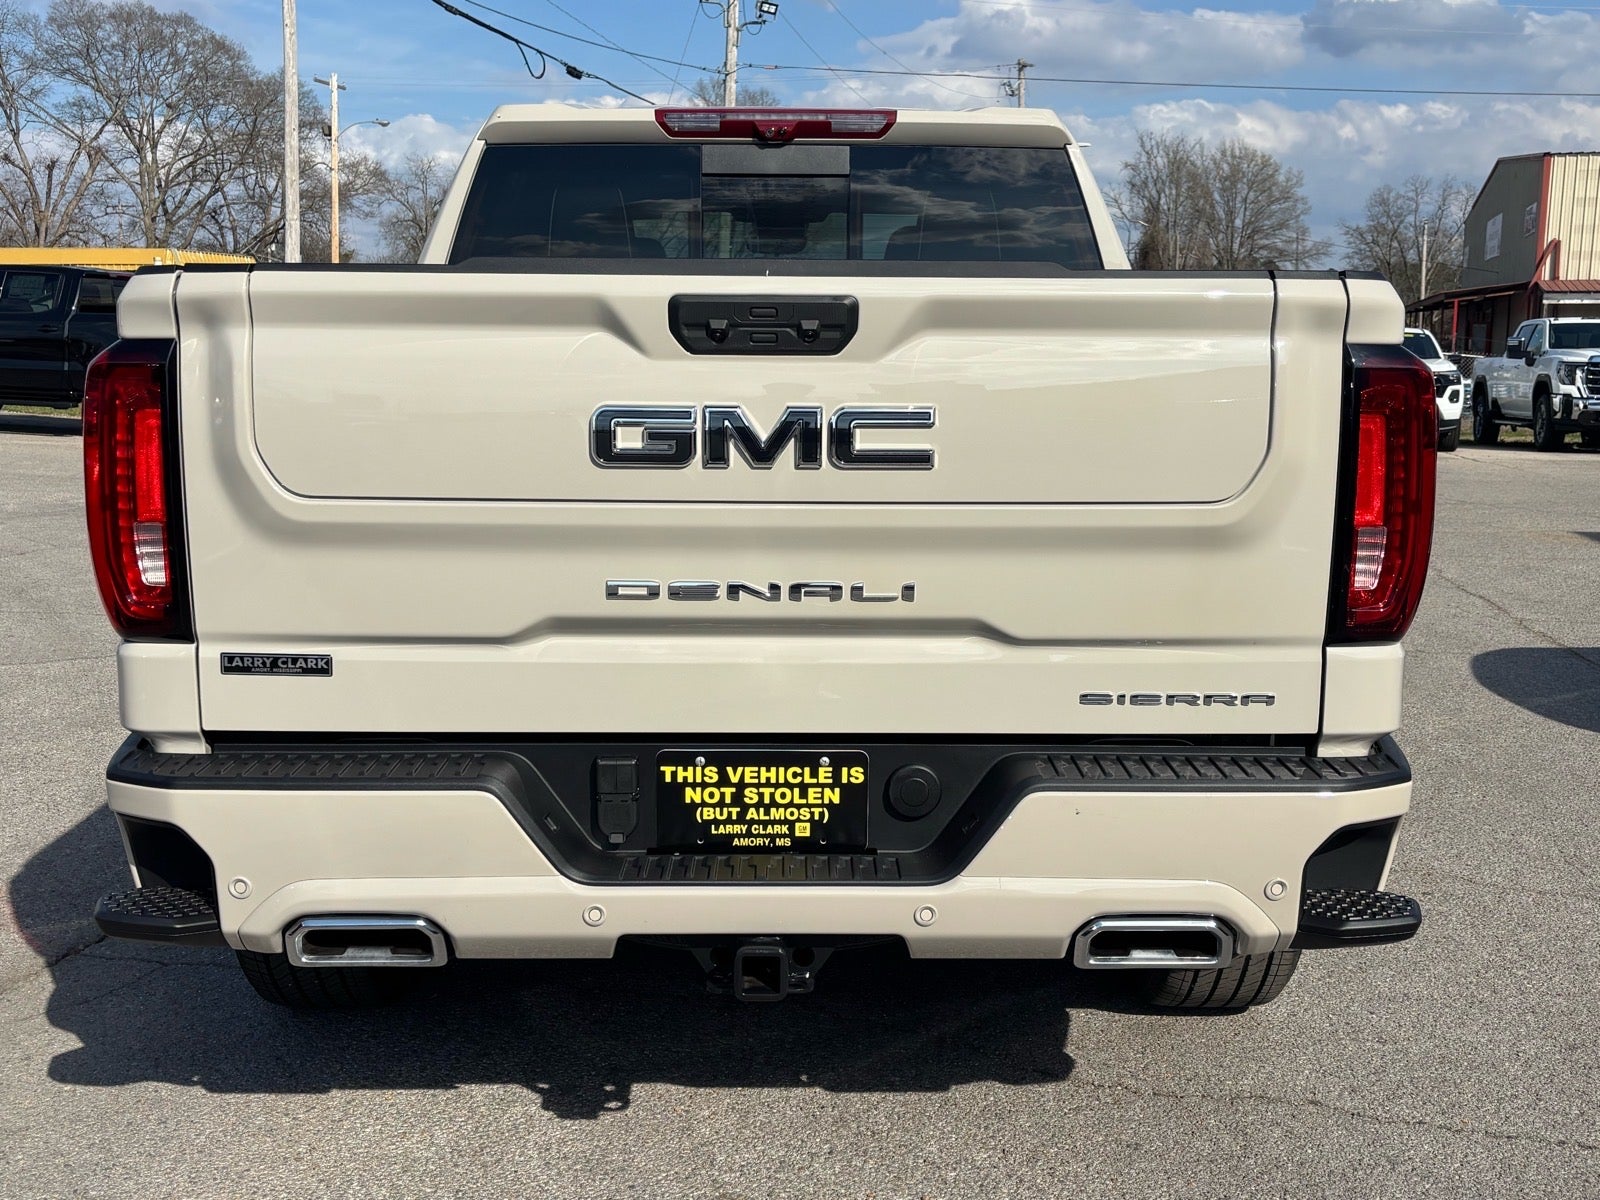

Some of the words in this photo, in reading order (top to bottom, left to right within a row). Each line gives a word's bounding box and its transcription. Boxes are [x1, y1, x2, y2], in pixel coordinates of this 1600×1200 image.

[589, 404, 935, 470] GMC
[606, 580, 916, 602] DENALI
[224, 656, 273, 667] LARRY
[277, 658, 329, 669] CLARK
[1079, 693, 1275, 706] SIERRA
[660, 766, 719, 783] THIS
[726, 766, 833, 784] VEHICLE
[841, 767, 865, 784] IS
[684, 787, 736, 804] NOT
[743, 787, 841, 804] STOLEN
[695, 807, 741, 823] (BUT
[745, 807, 829, 823] ALMOST)
[711, 824, 747, 834] LARRY
[751, 824, 789, 834] CLARK
[732, 837, 773, 847] AMORY,
[775, 837, 791, 847] MS
